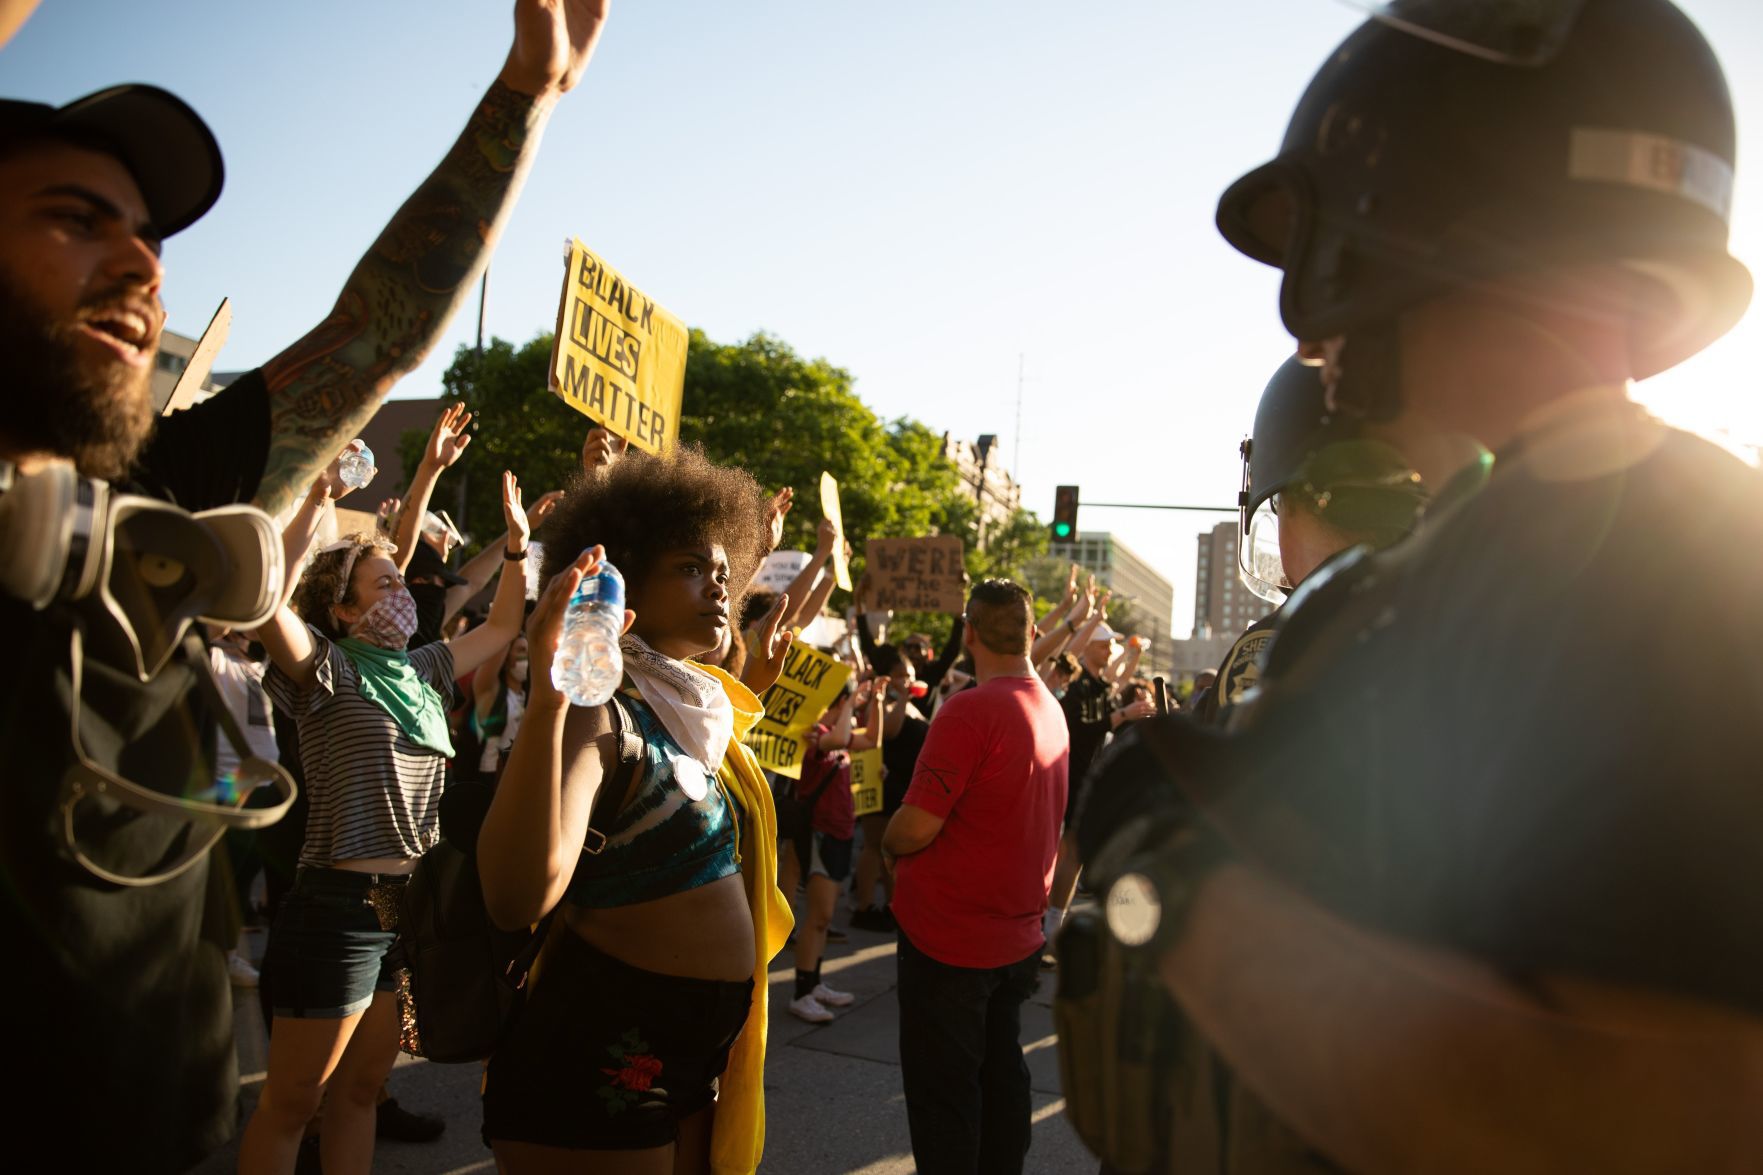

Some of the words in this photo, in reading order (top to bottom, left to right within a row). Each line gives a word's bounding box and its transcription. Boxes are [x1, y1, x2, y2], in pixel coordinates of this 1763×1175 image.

[578, 250, 655, 335] BLACK
[572, 299, 640, 382] LIVES
[563, 354, 666, 451] MATTER
